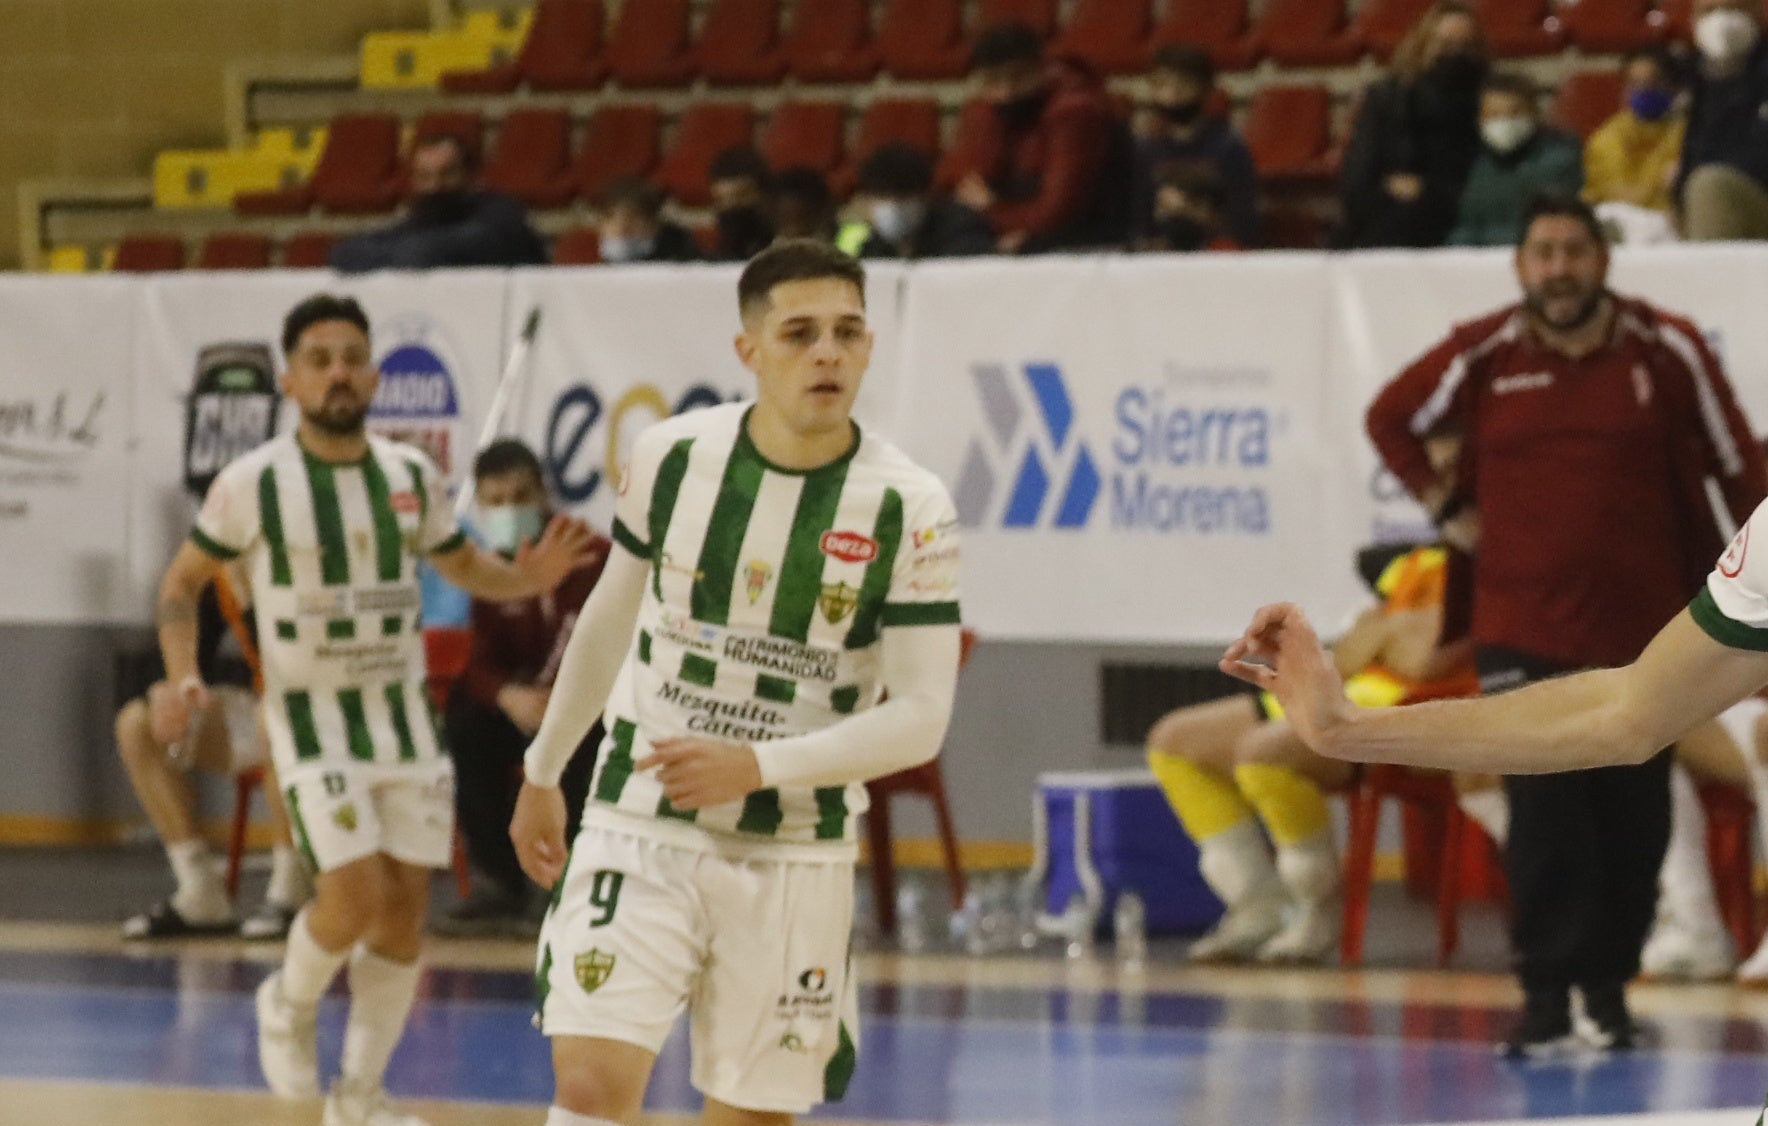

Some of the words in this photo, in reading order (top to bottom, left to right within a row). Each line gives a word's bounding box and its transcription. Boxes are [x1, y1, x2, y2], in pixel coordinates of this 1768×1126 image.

[1113, 386, 1268, 466] Sierra
[1111, 471, 1269, 534] Morena
[723, 647, 838, 682] HUMANIDAD
[725, 634, 829, 665] PATRIMONIO
[589, 869, 626, 928] 9
